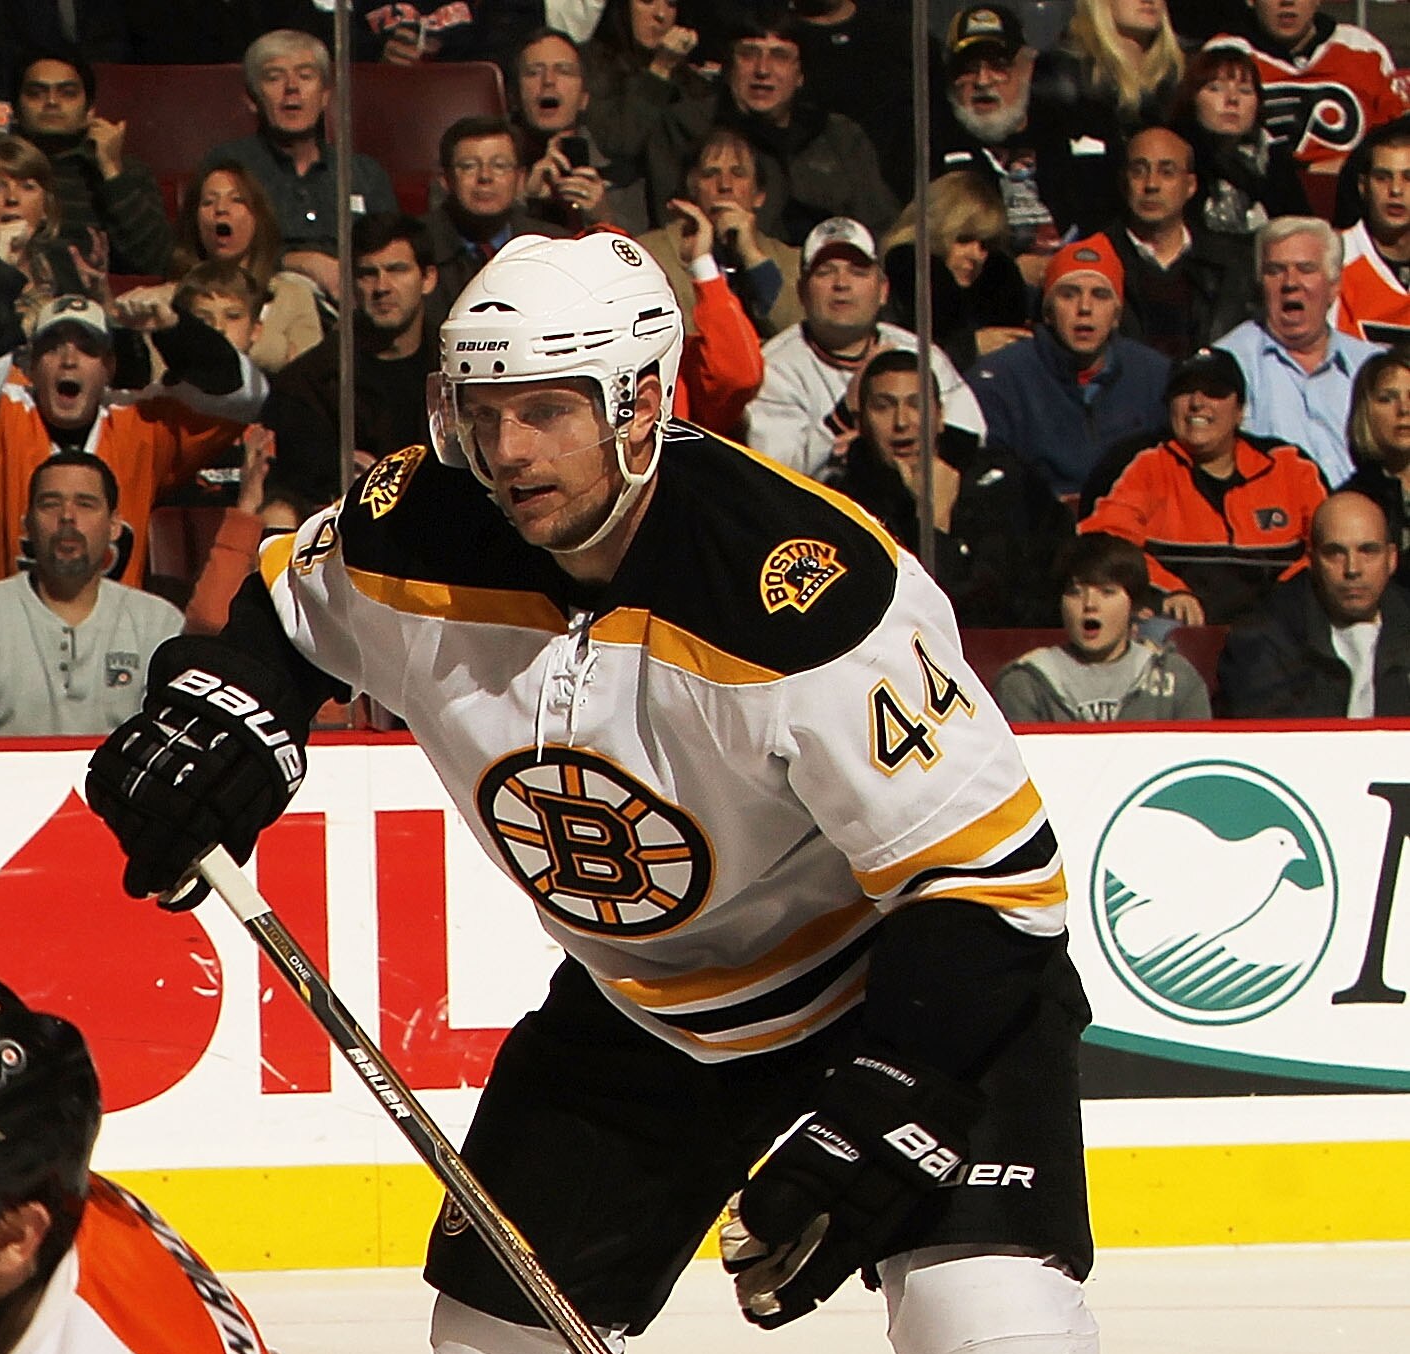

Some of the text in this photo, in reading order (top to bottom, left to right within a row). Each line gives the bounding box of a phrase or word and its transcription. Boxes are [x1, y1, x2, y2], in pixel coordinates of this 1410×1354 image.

[456, 341, 510, 351] BAUER
[764, 542, 832, 609] BOSTON
[167, 668, 304, 794] BAUE
[869, 630, 977, 779] 44
[346, 1047, 411, 1120] BAUER
